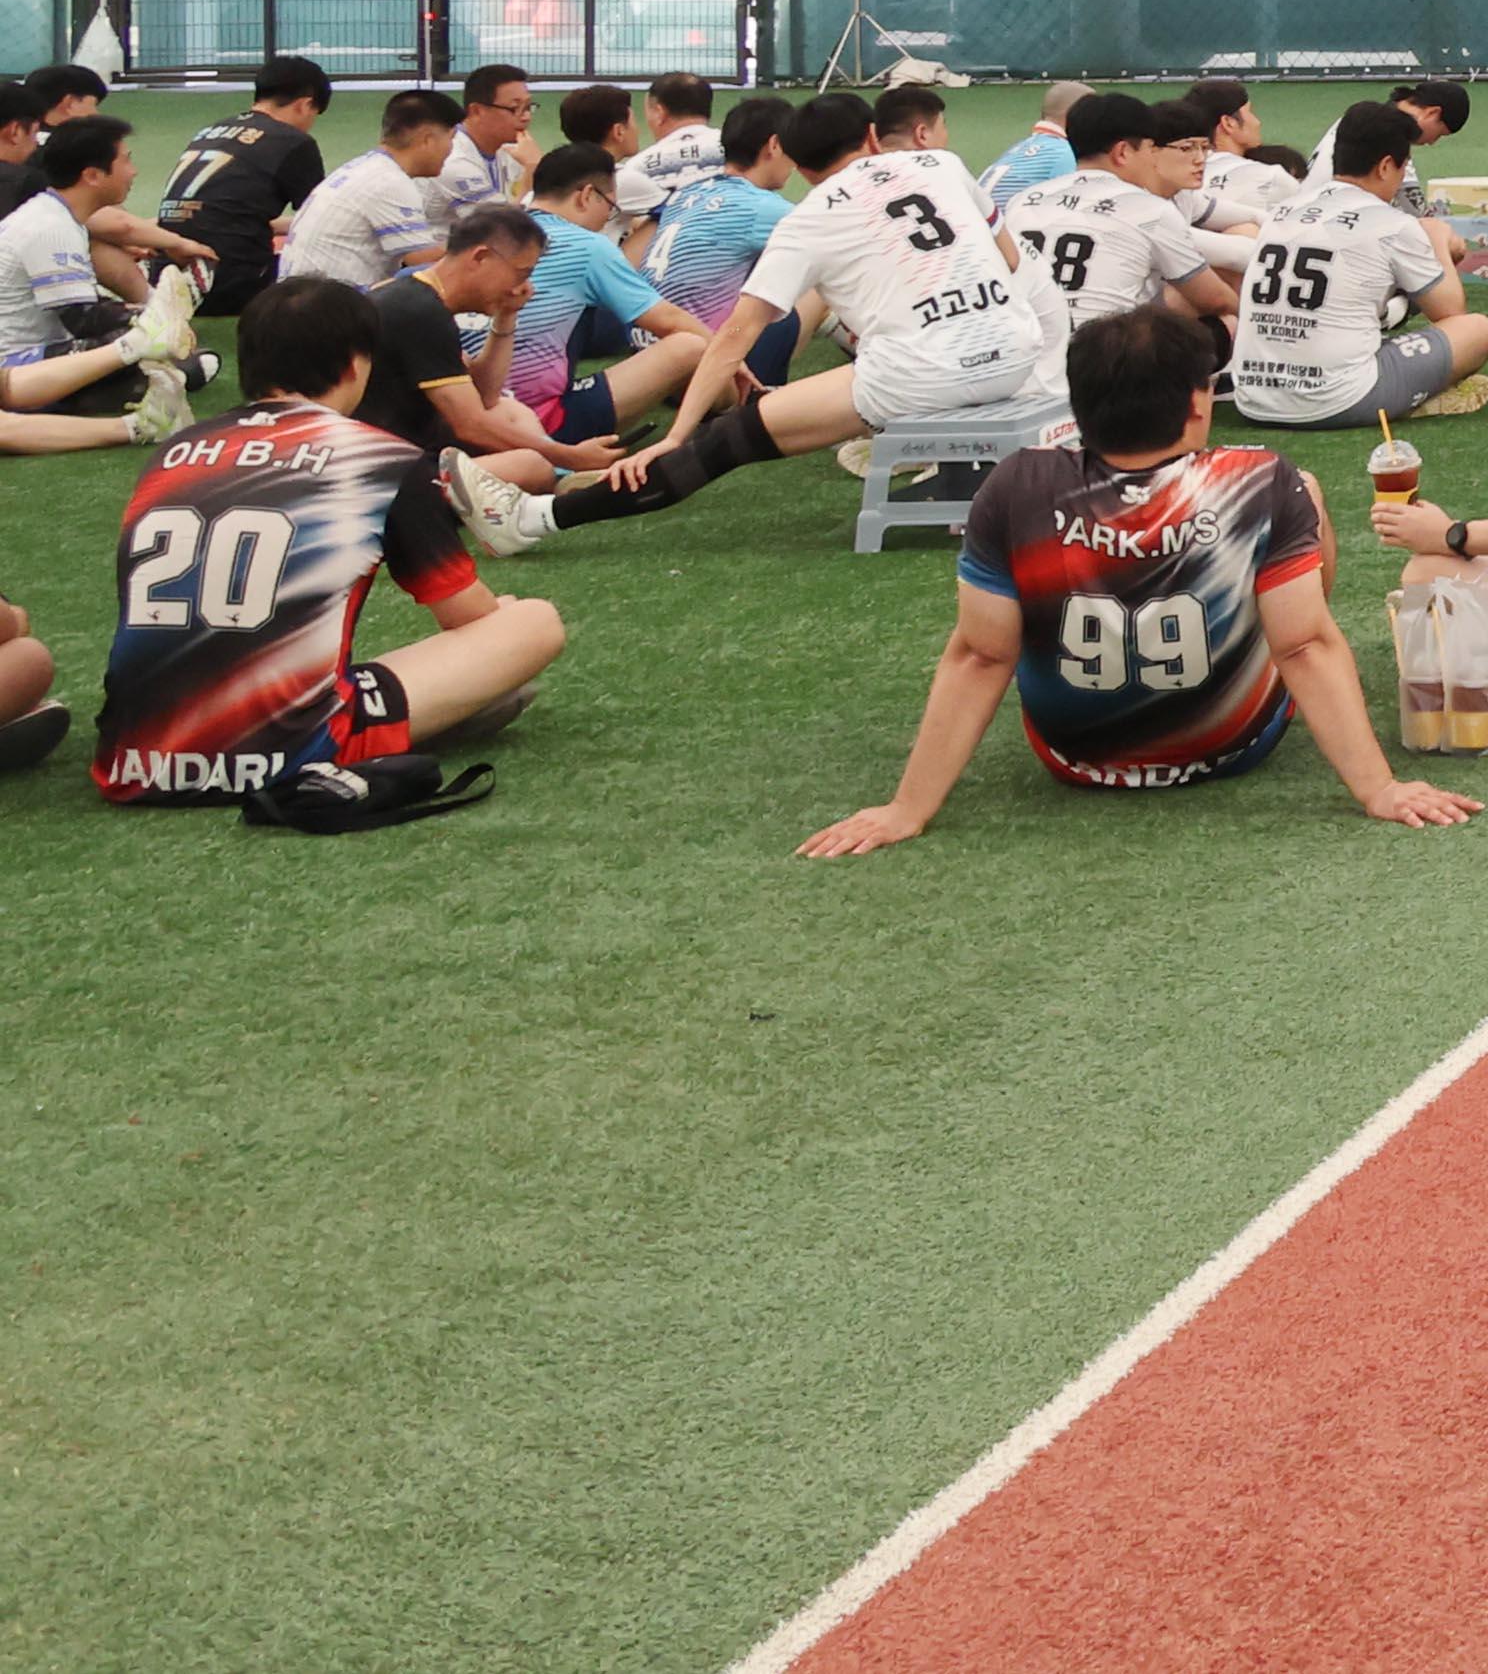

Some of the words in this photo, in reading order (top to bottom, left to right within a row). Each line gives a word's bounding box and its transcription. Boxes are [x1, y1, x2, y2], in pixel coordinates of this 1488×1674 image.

[886, 192, 958, 252] 3
[912, 279, 1010, 329] 고고JC
[1252, 243, 1334, 311] 35
[1250, 312, 1281, 325] JOKGU
[1284, 315, 1318, 329] PRIDE
[1257, 324, 1268, 335] IN
[161, 437, 226, 474] OH
[126, 504, 297, 630] 20
[1057, 591, 1213, 692] 99
